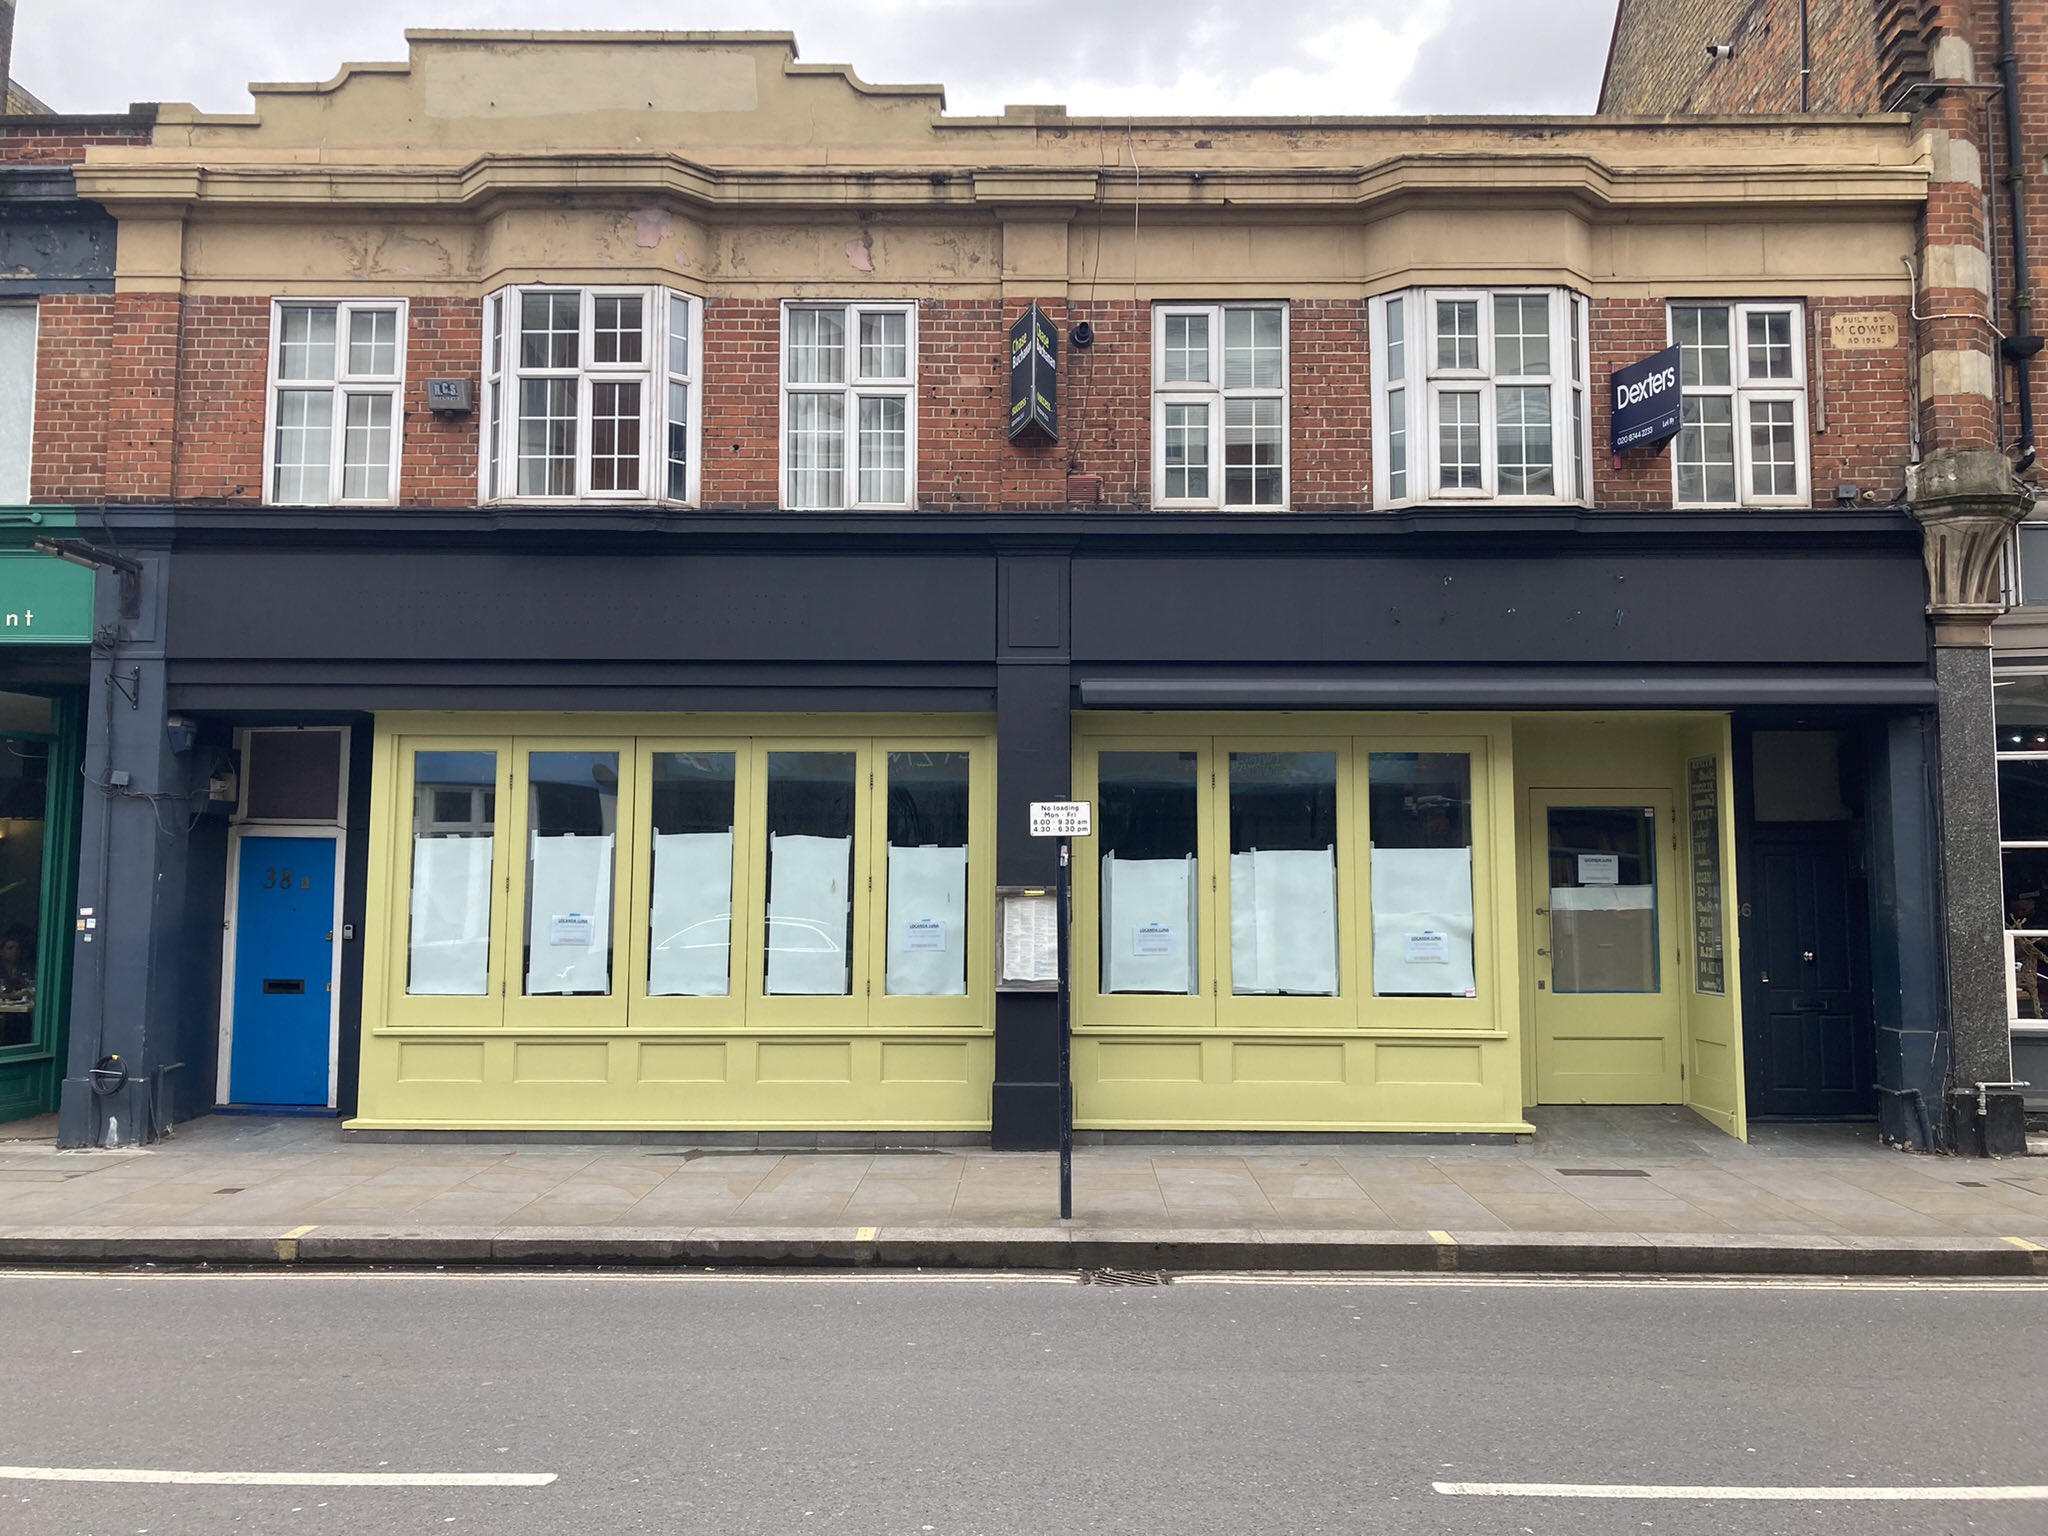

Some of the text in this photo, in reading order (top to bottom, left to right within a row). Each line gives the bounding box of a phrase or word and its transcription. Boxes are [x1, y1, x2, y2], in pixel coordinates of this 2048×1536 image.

[1842, 316, 1869, 324] BUILT
[1848, 325, 1895, 335] COWEN
[1617, 366, 1676, 410] Dexters
[1053, 804, 1080, 812] loading
